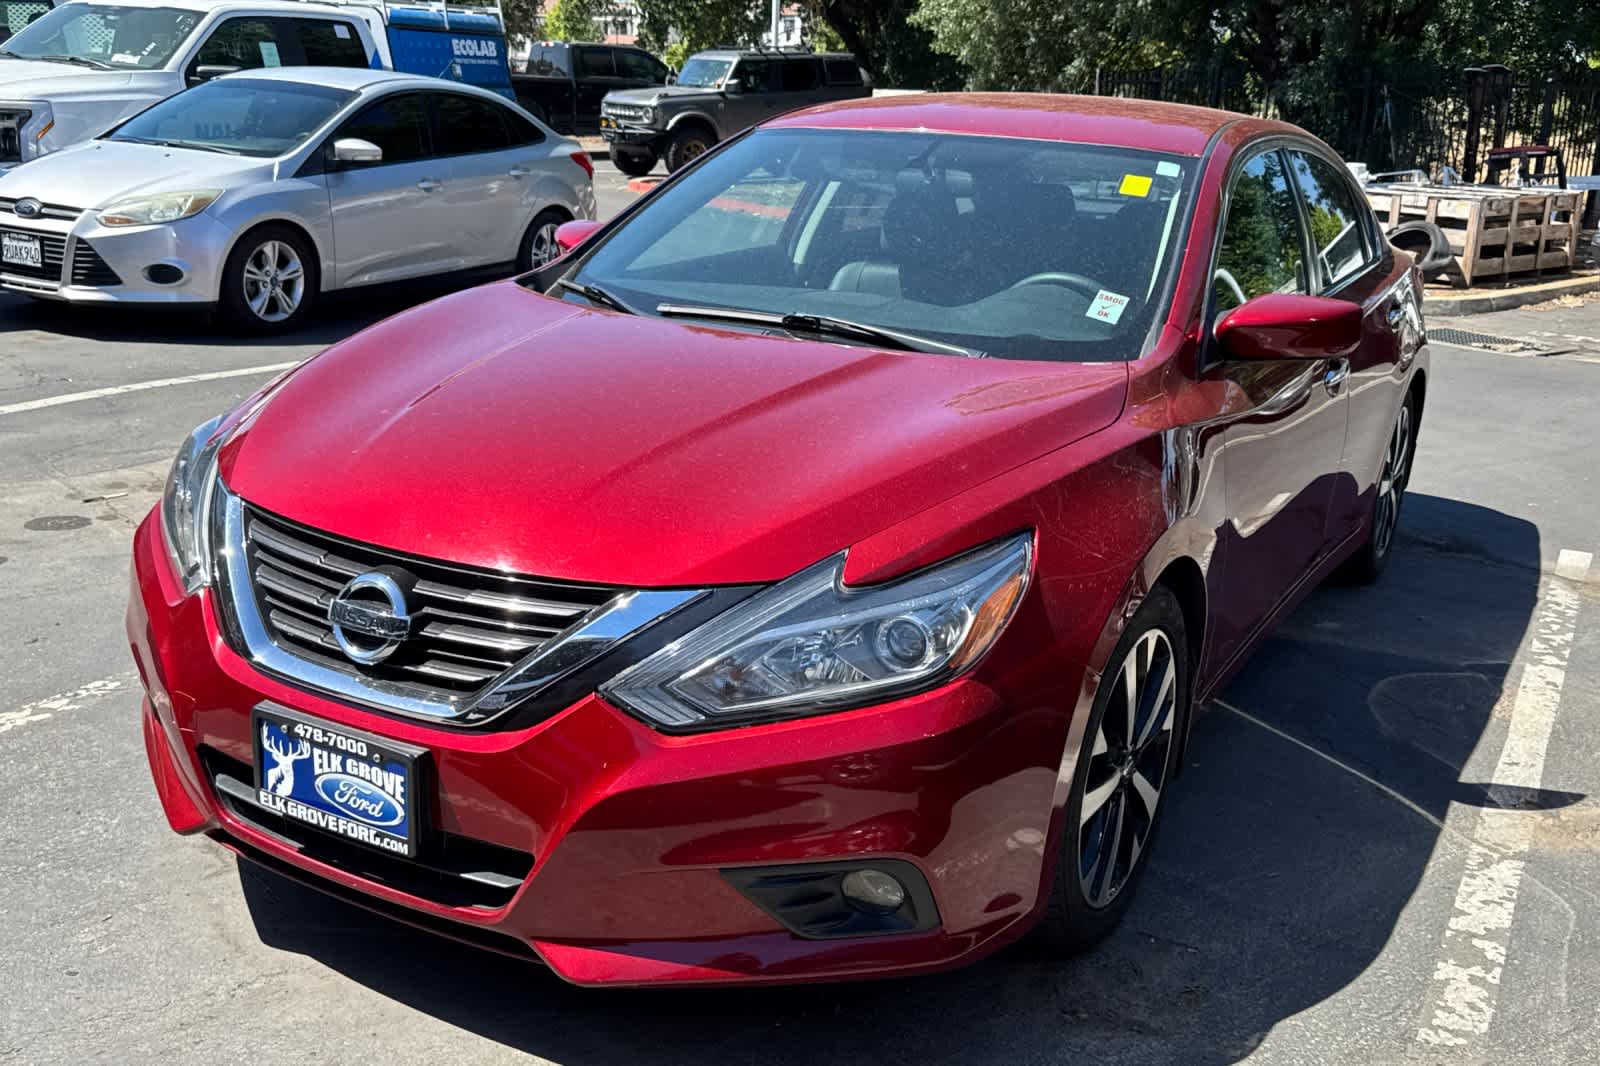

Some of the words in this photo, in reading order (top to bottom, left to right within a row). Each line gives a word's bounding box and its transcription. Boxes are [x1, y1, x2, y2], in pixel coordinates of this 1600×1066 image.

[451, 38, 497, 57] ECOLAB
[1097, 310, 1110, 318] OK
[1099, 293, 1124, 305] SMOG
[333, 602, 401, 634] NISSAN
[294, 723, 368, 757] 478-7000
[313, 747, 343, 775] ELK
[346, 758, 404, 805] GROVE
[334, 780, 383, 818] Ford
